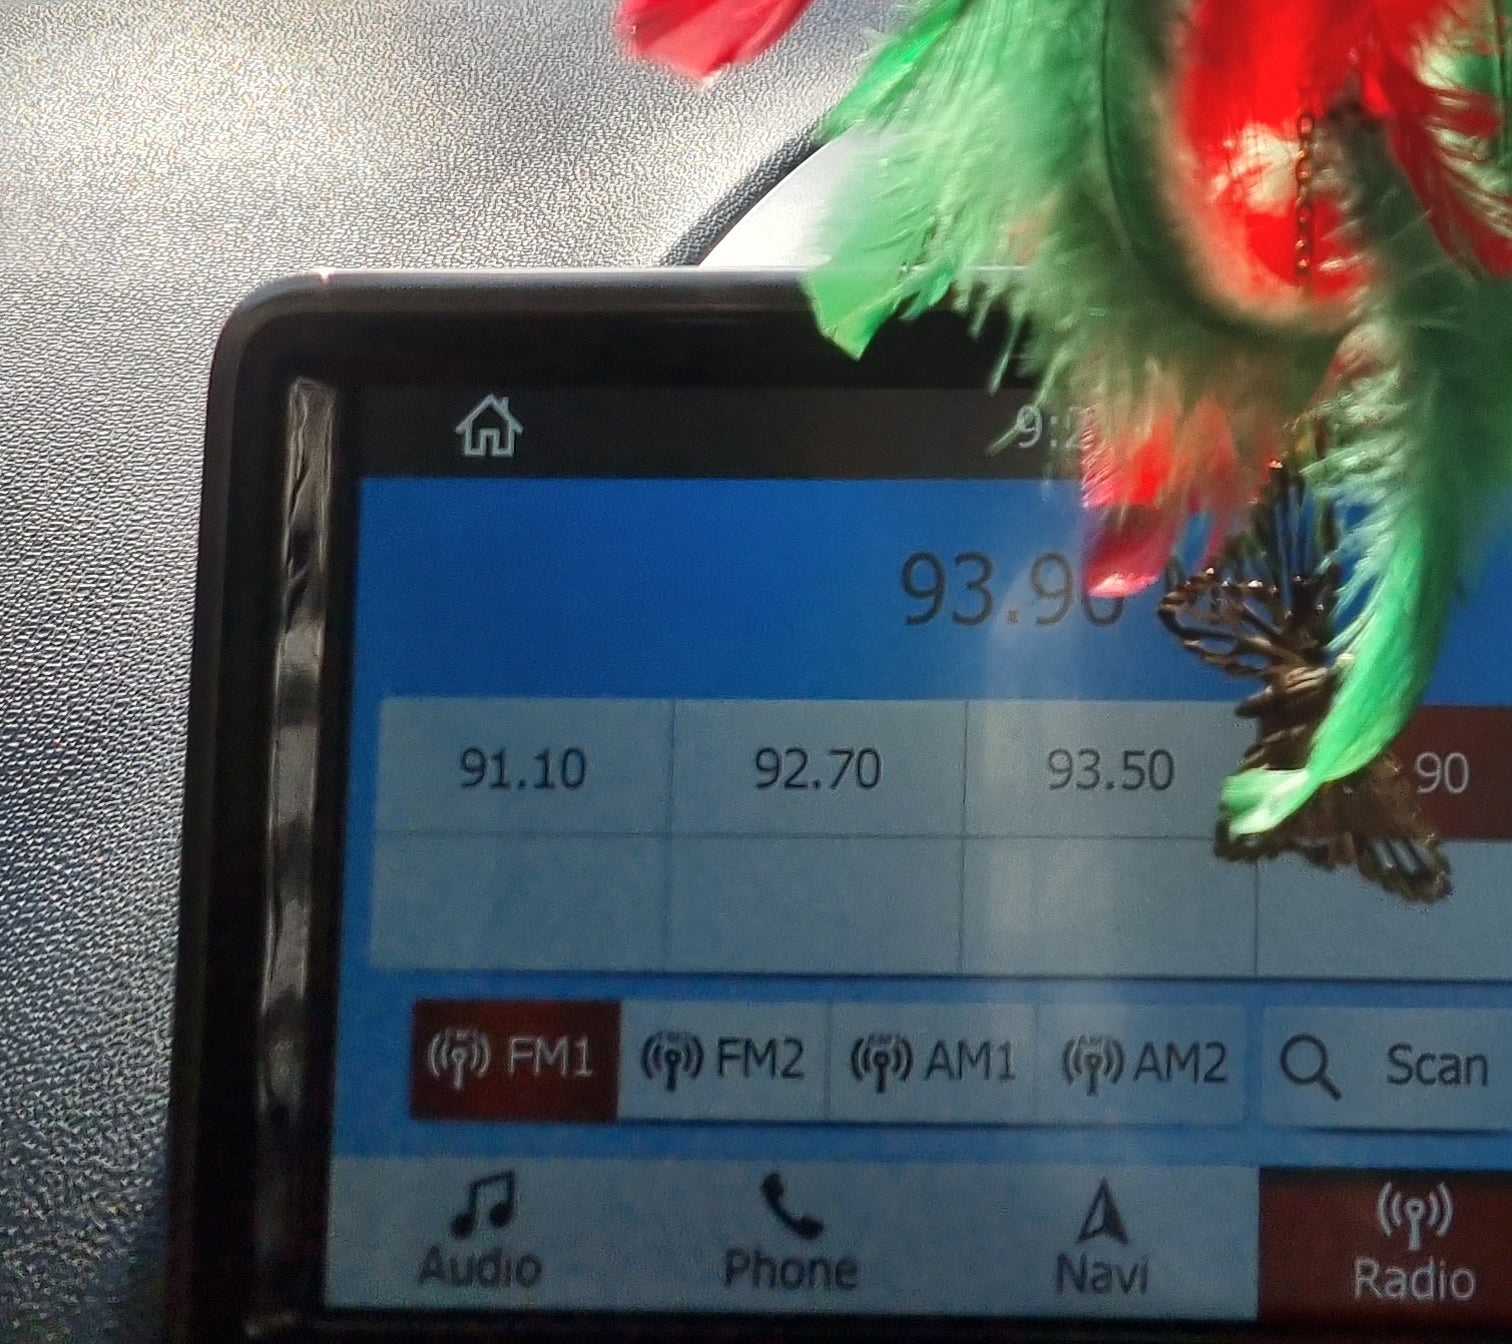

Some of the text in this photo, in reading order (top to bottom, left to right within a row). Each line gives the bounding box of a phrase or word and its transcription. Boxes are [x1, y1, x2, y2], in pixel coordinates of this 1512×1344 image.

[459, 747, 588, 792] 91.10
[753, 747, 883, 792] 92.70
[1046, 748, 1175, 793] 93.50
[1414, 751, 1470, 794] 90
[508, 1035, 594, 1079] FM1
[716, 1037, 804, 1079] FM2
[924, 1040, 1017, 1081] AM1
[1133, 1042, 1228, 1083] AM2
[1386, 1043, 1489, 1088] Scan
[417, 1245, 543, 1288] Audio
[724, 1247, 860, 1291] Phone
[1056, 1251, 1150, 1295] Navi
[1353, 1256, 1477, 1302] Radio
